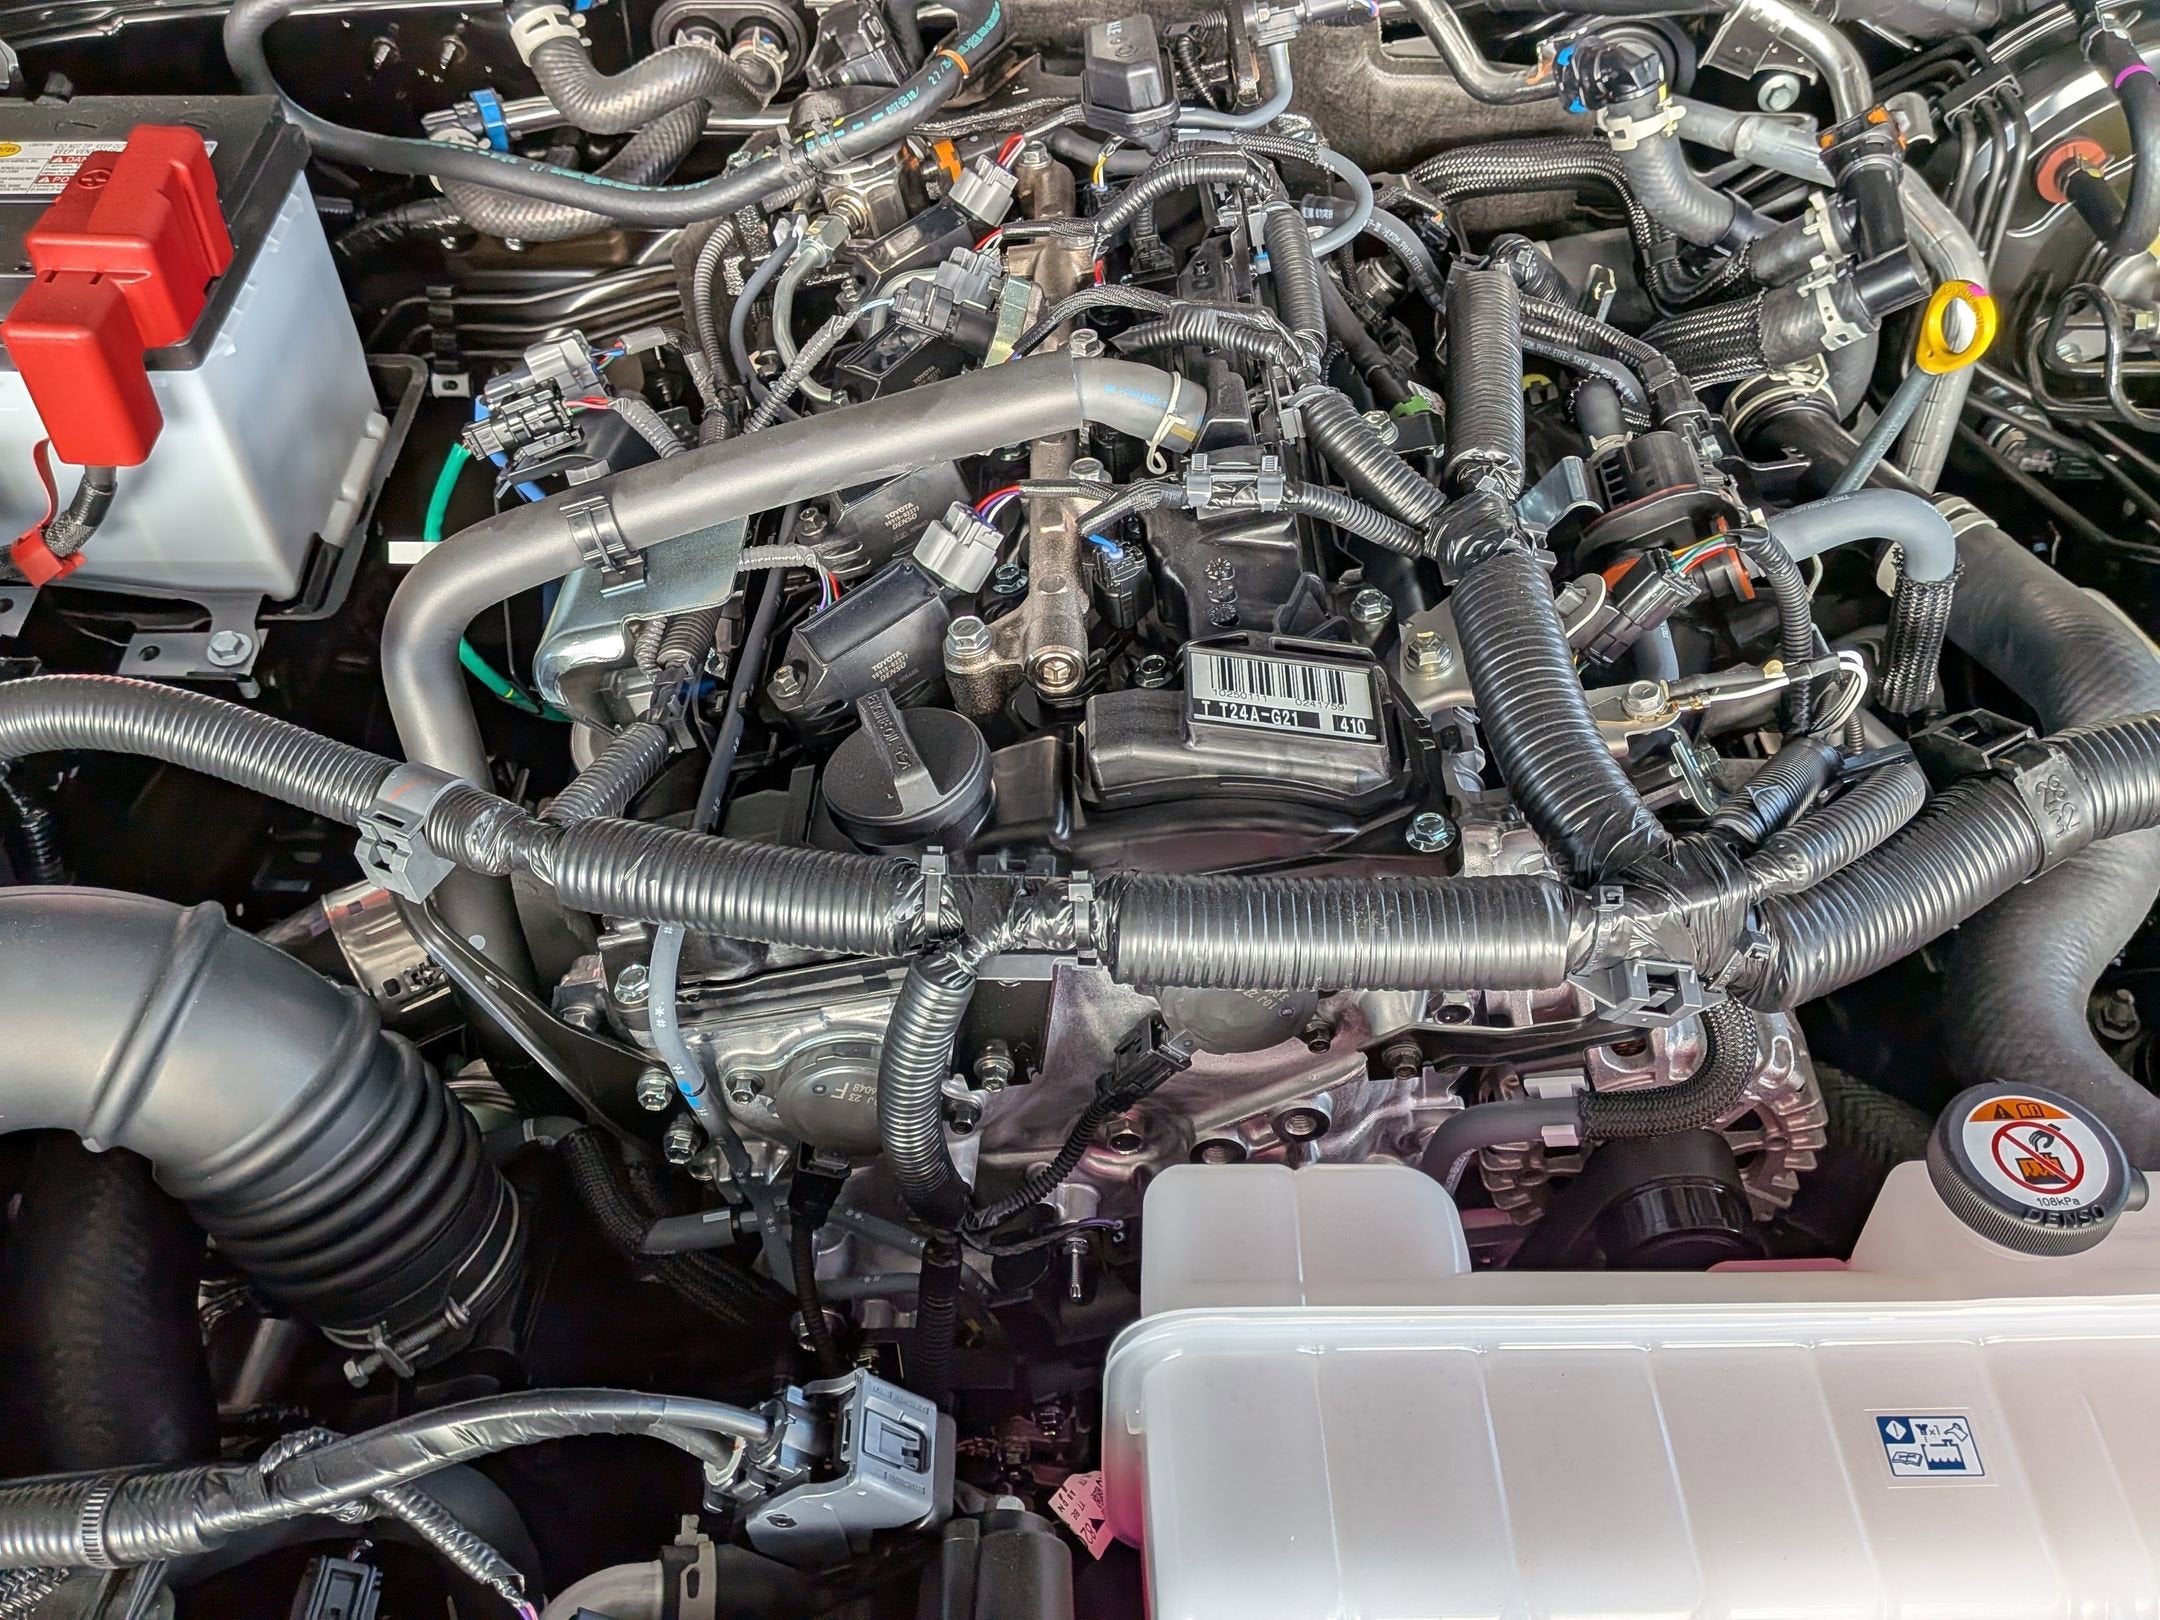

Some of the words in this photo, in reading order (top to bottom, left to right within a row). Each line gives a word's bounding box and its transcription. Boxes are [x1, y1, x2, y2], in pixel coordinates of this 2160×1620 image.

[884, 502, 914, 520] TOYOTA
[892, 513, 918, 530] DENSO
[871, 650, 903, 671] TOYOTA
[880, 661, 907, 682] DENSO
[1212, 688, 1268, 703] 10250111
[1295, 698, 1346, 712] 0241759
[1201, 700, 1212, 716] T
[1219, 702, 1300, 727] T24A-G21
[1340, 717, 1367, 735] 410
[2036, 1196, 2081, 1208] 108kPa
[2023, 1204, 2105, 1230] DENSO
